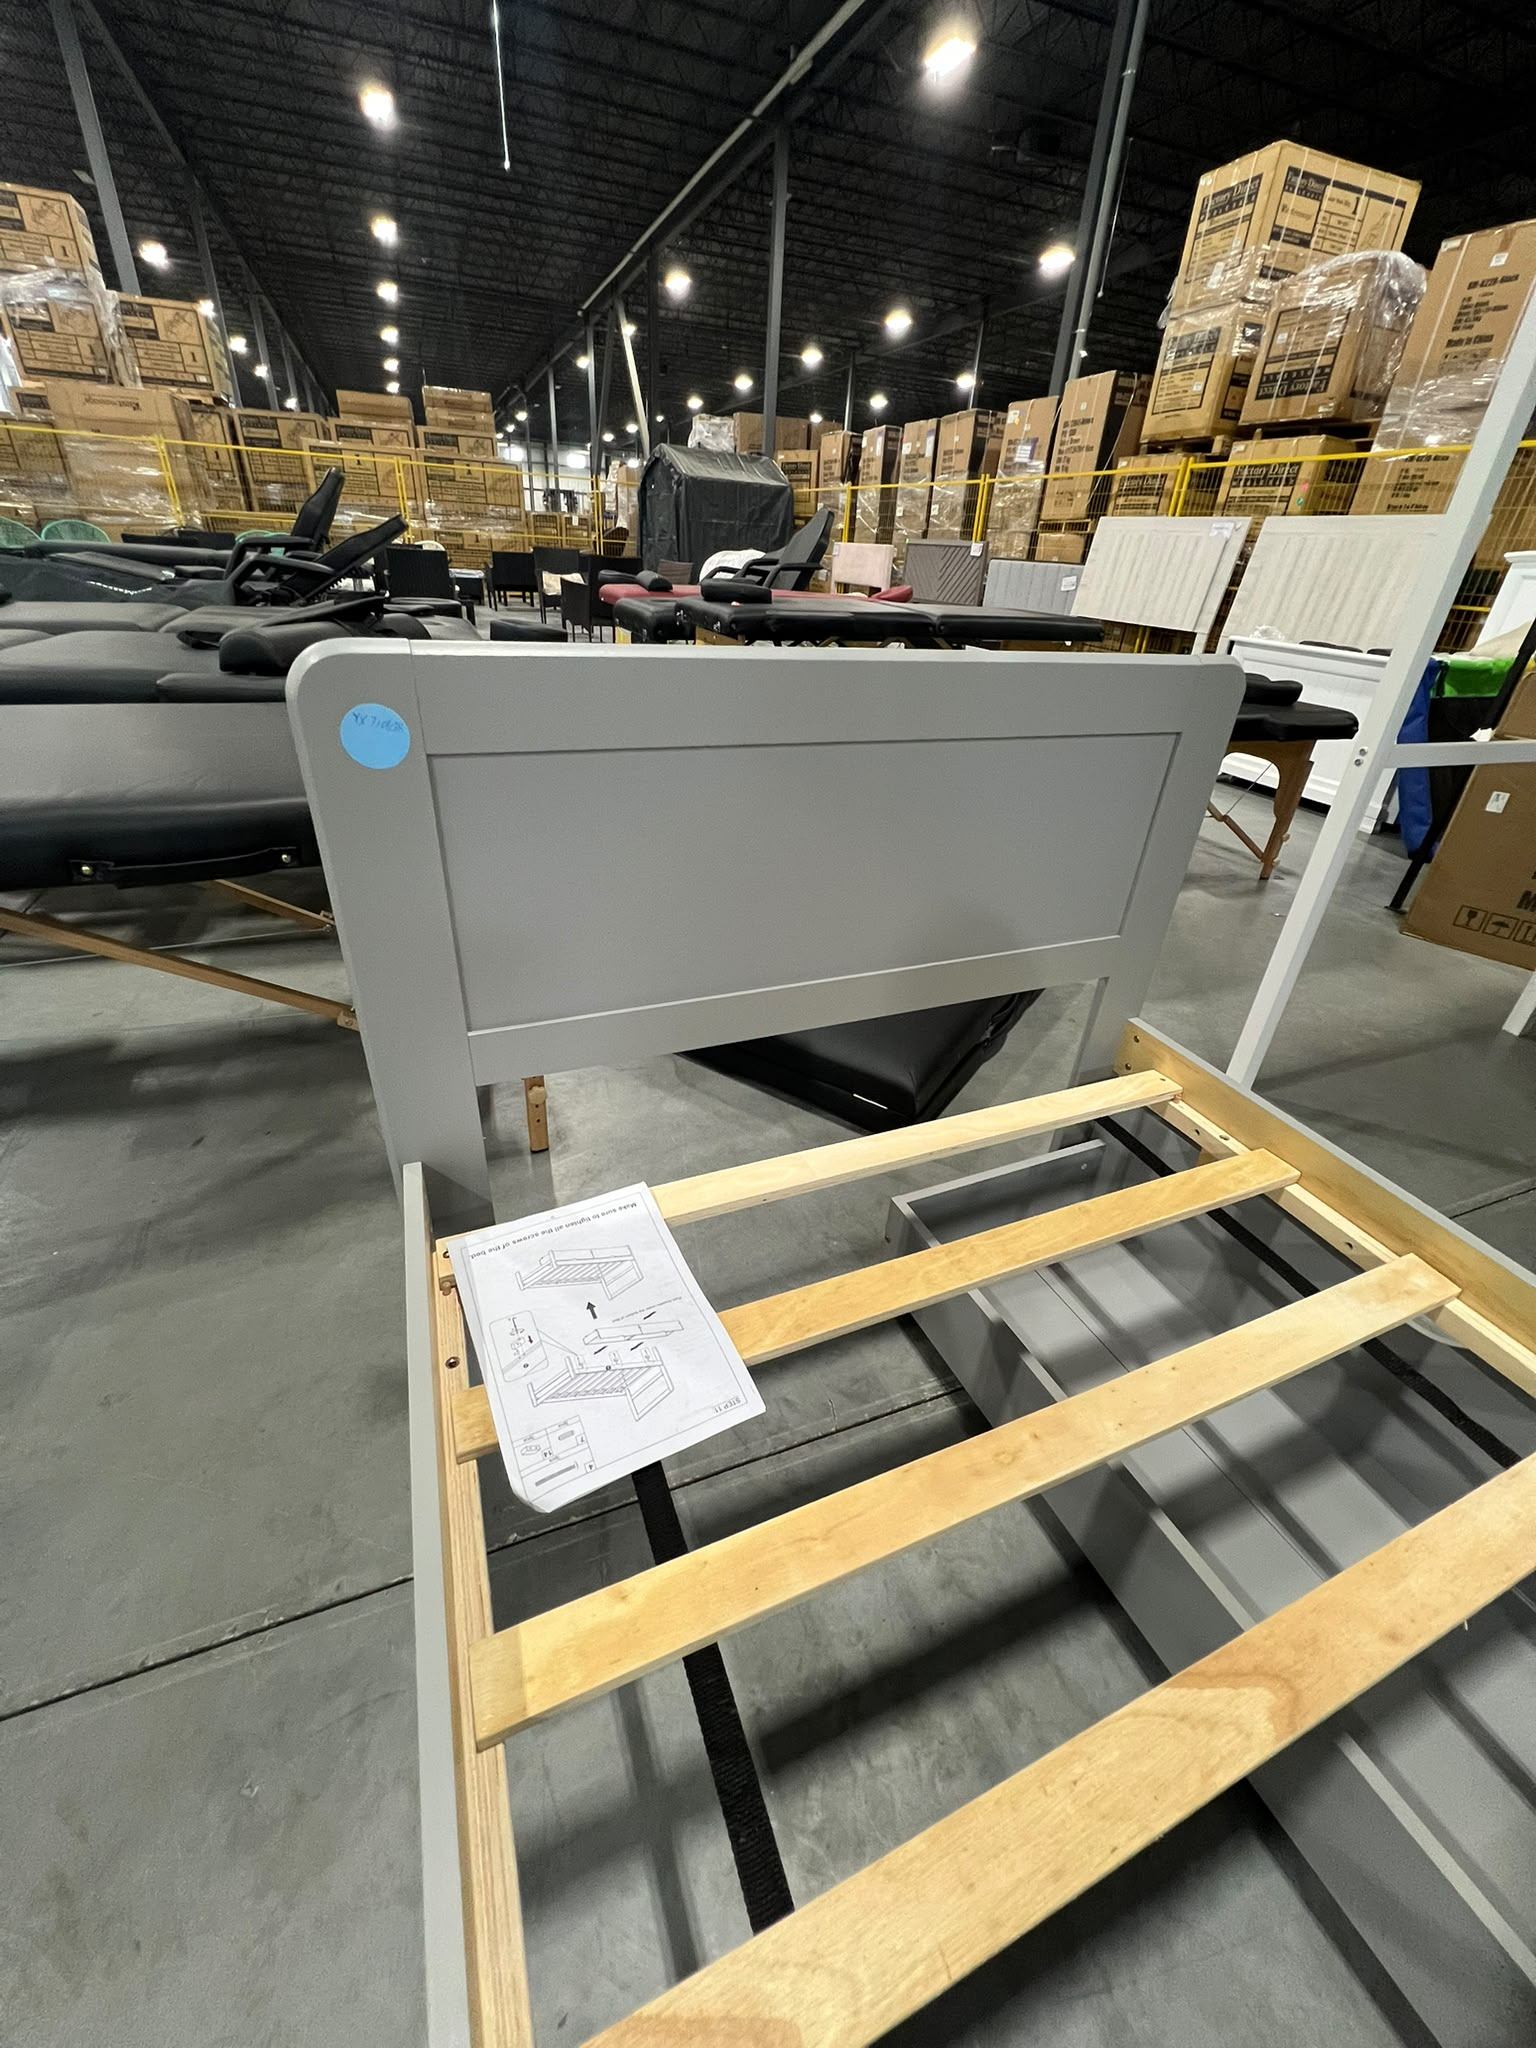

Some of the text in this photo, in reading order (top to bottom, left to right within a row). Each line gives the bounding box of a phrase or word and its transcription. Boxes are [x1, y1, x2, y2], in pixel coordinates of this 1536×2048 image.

[618, 1202, 637, 1211] Make
[601, 1208, 617, 1217] sure
[564, 1216, 591, 1228] tighten
[541, 1227, 554, 1235] the
[512, 1232, 539, 1244] screws
[488, 1245, 501, 1253] the
[723, 1397, 741, 1409] STEP
